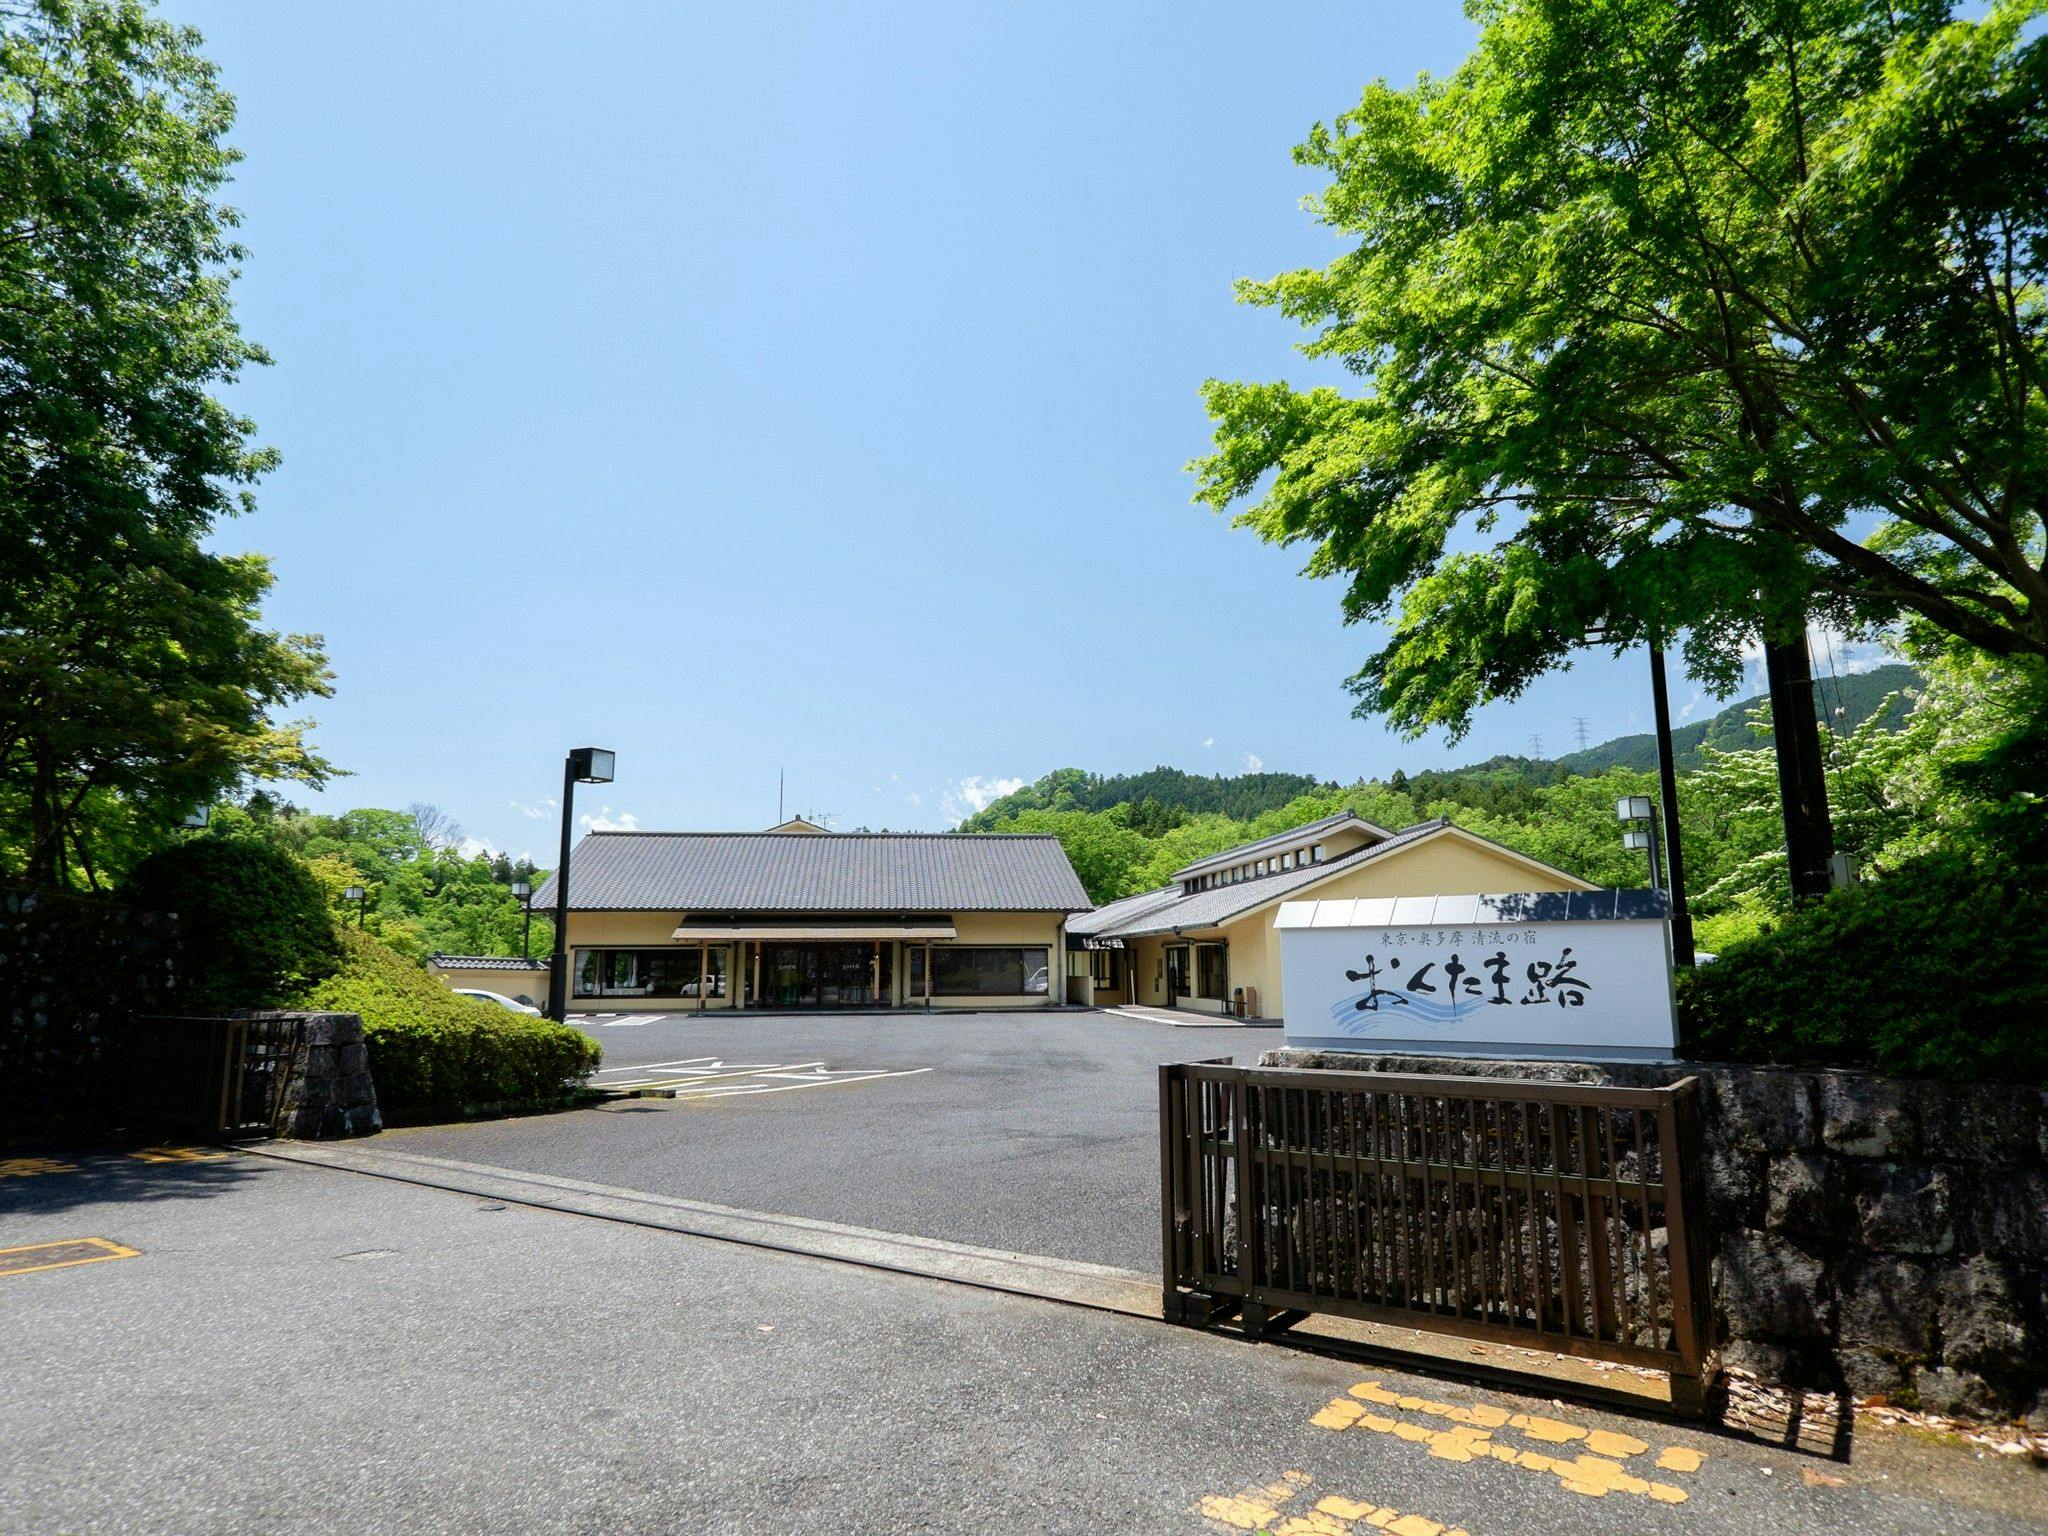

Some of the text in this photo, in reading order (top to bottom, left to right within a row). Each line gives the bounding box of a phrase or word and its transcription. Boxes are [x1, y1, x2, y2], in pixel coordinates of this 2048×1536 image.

[1472, 929, 1537, 946] 清流の宿
[1345, 947, 1592, 1017] おくたま路
